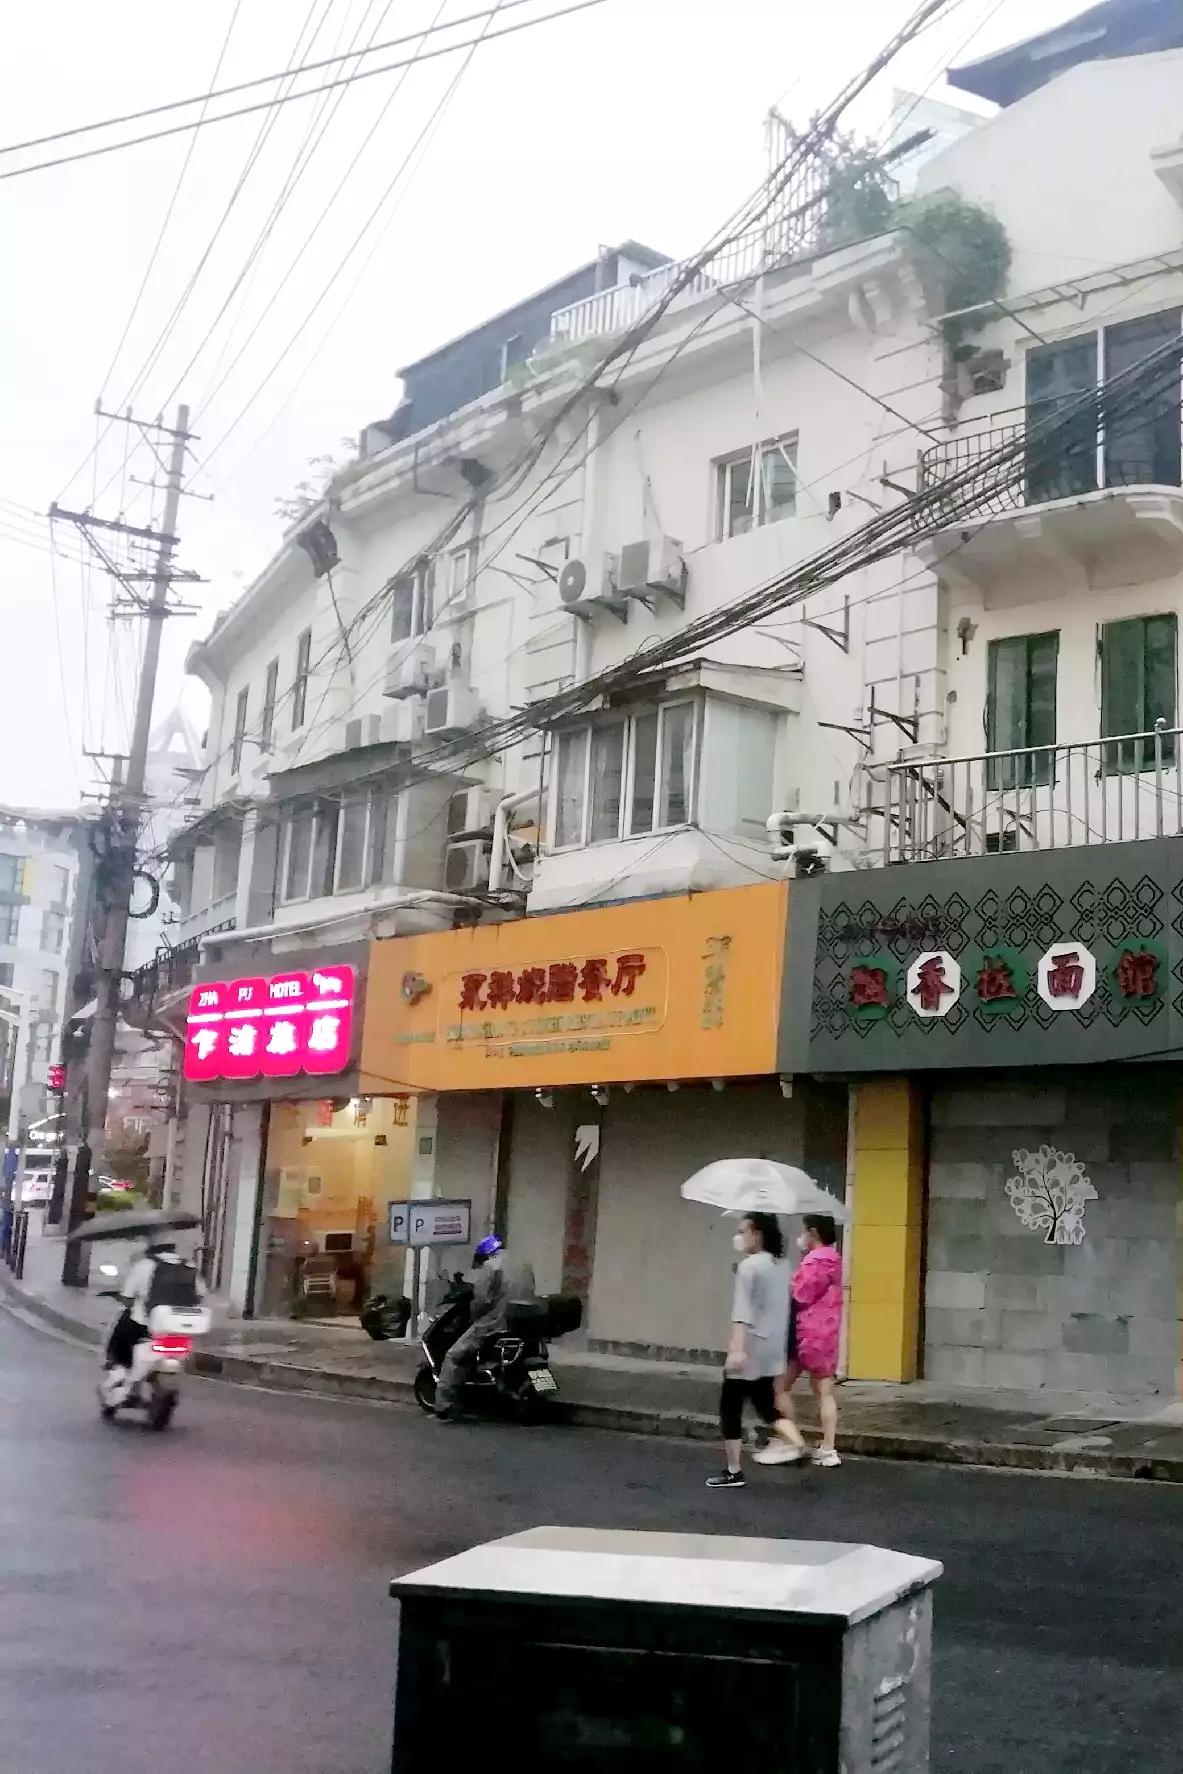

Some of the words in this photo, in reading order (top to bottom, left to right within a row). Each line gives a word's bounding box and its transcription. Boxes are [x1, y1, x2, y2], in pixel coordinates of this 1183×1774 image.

[269, 980, 304, 998] HOTEL
[393, 1215, 404, 1232] P
[415, 1218, 425, 1232] P
